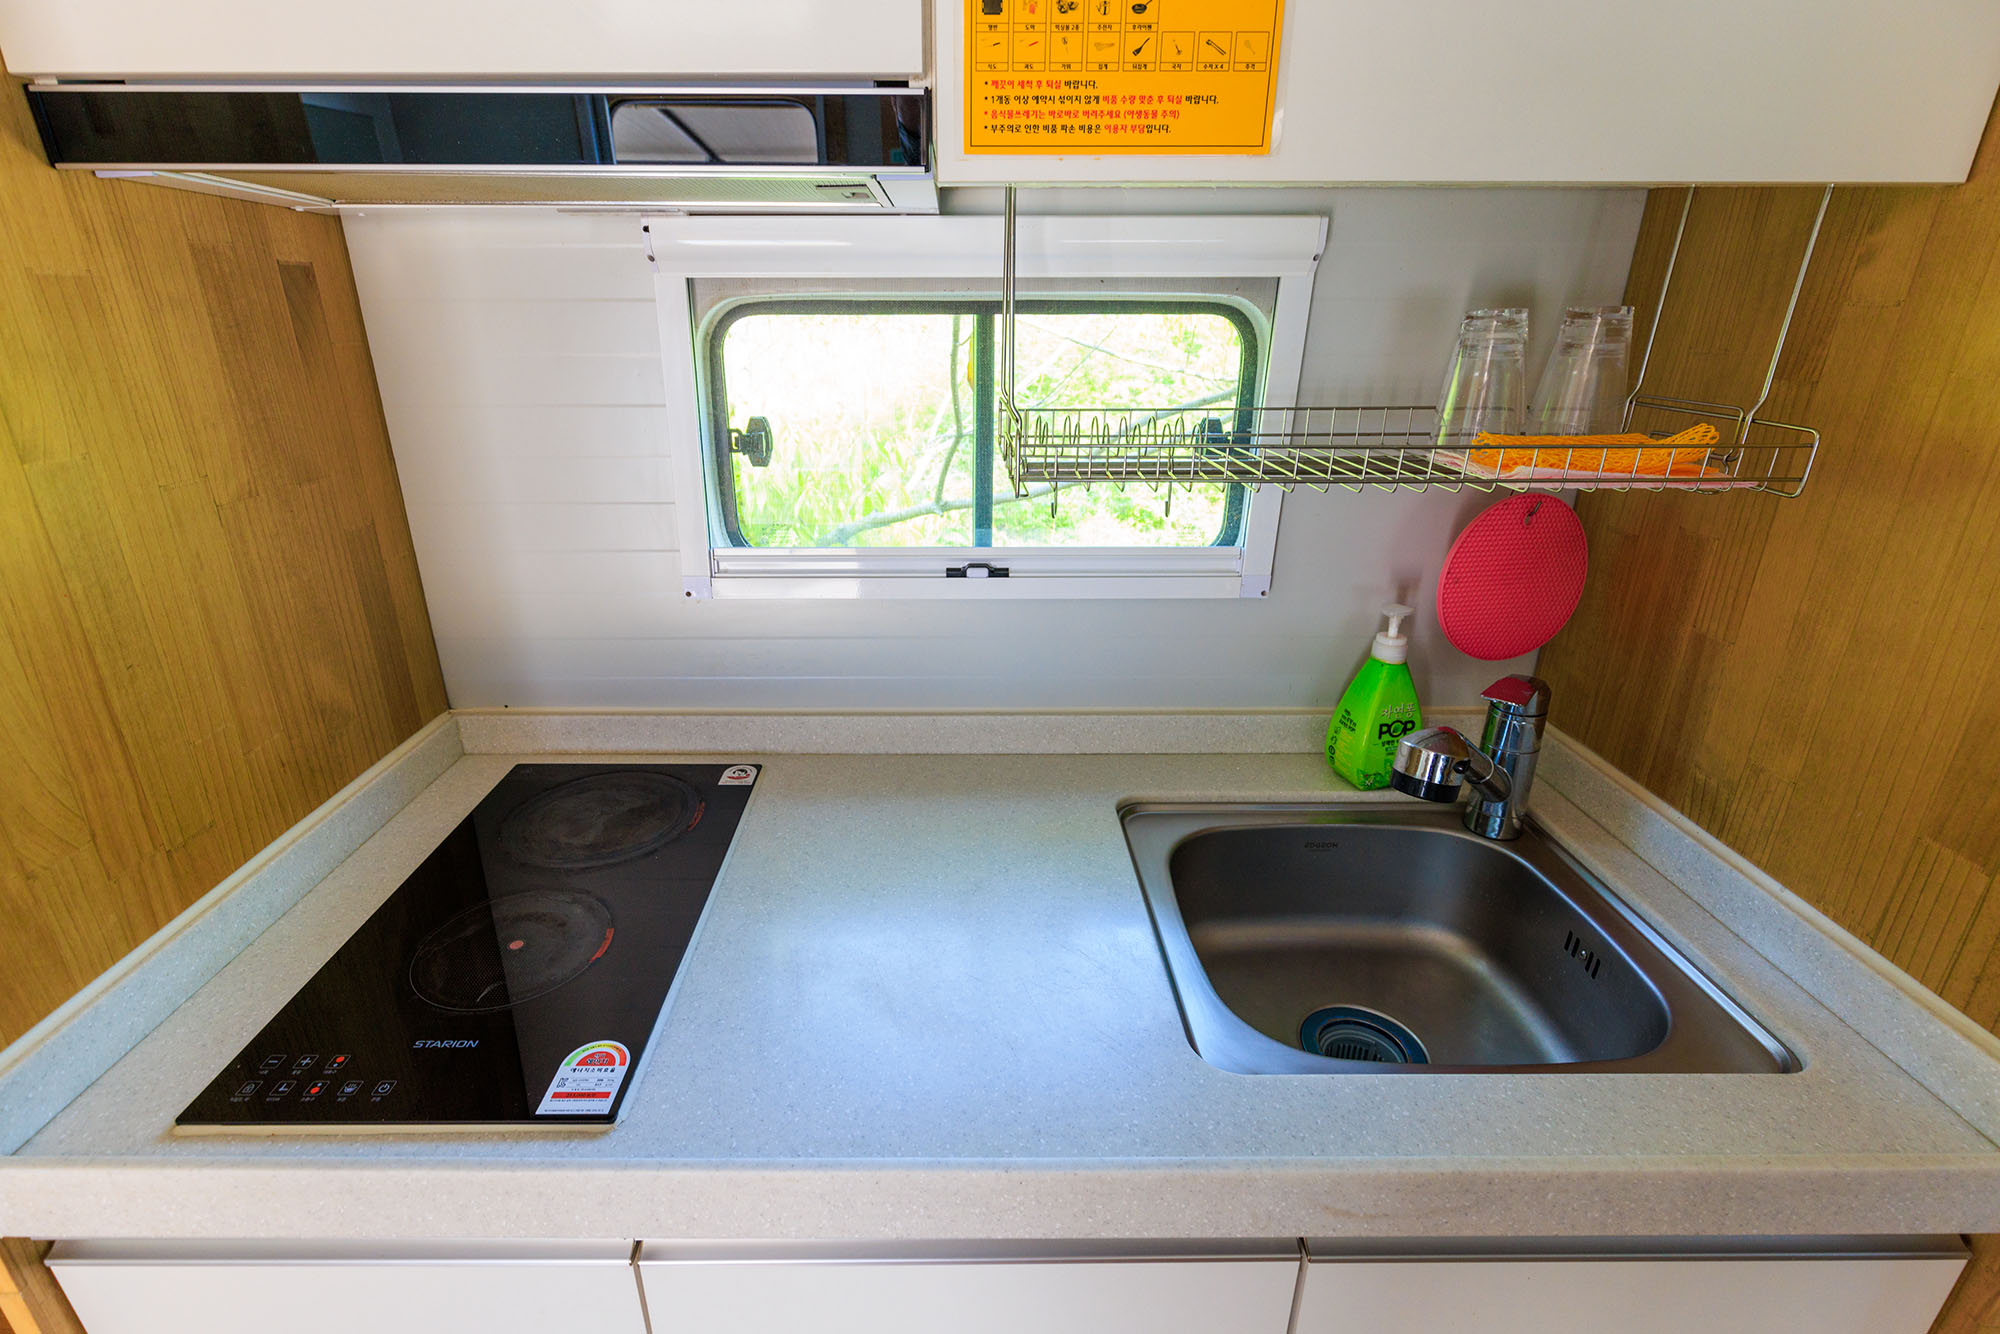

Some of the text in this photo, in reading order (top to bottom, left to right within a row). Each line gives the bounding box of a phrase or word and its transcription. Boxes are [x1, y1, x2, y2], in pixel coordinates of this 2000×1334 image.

[991, 80, 1098, 89] 깨끗이 세척 후 퇴실 바랍니다.
[991, 95, 1219, 105] 1개동 이상 예약시 섞이지 않게 비품 수량 맞춘 후 퇴실 바랍니다.
[991, 110, 1180, 120] 음식물쓰레기는 바로바로 버려주세요 (야생동물 주의)
[991, 124, 1171, 134] 부주의로 인한 비품 파손 비용은 이용자 부담입니다.
[1382, 703, 1416, 719] 자연퐁
[1379, 720, 1415, 739] POP
[413, 1040, 479, 1048] STARION
